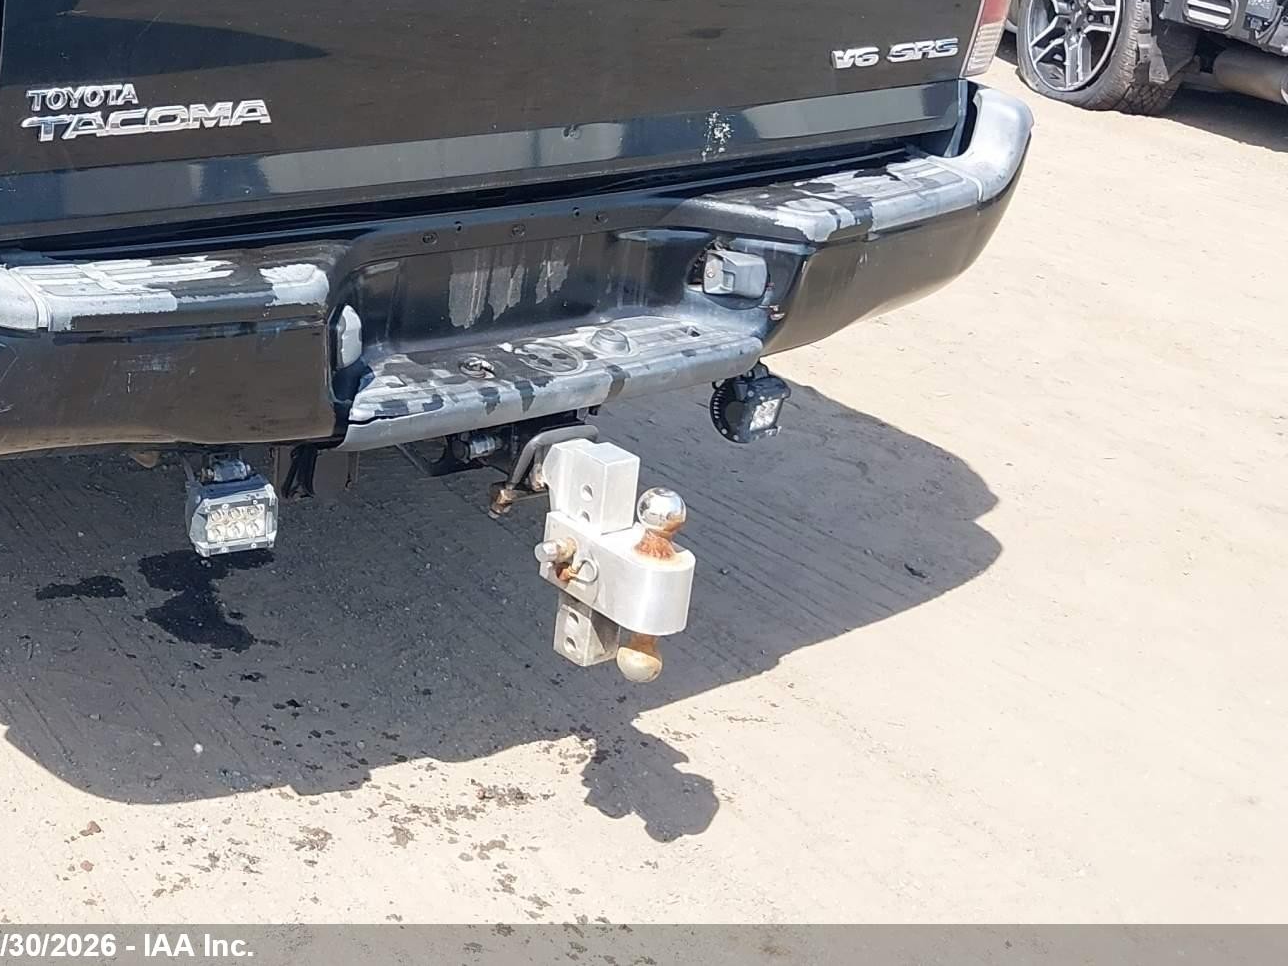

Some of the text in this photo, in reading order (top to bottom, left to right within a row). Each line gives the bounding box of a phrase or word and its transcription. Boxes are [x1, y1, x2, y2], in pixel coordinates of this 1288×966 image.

[831, 37, 959, 69] V6 SR5
[20, 83, 272, 142] TOYOTA TACOMA
